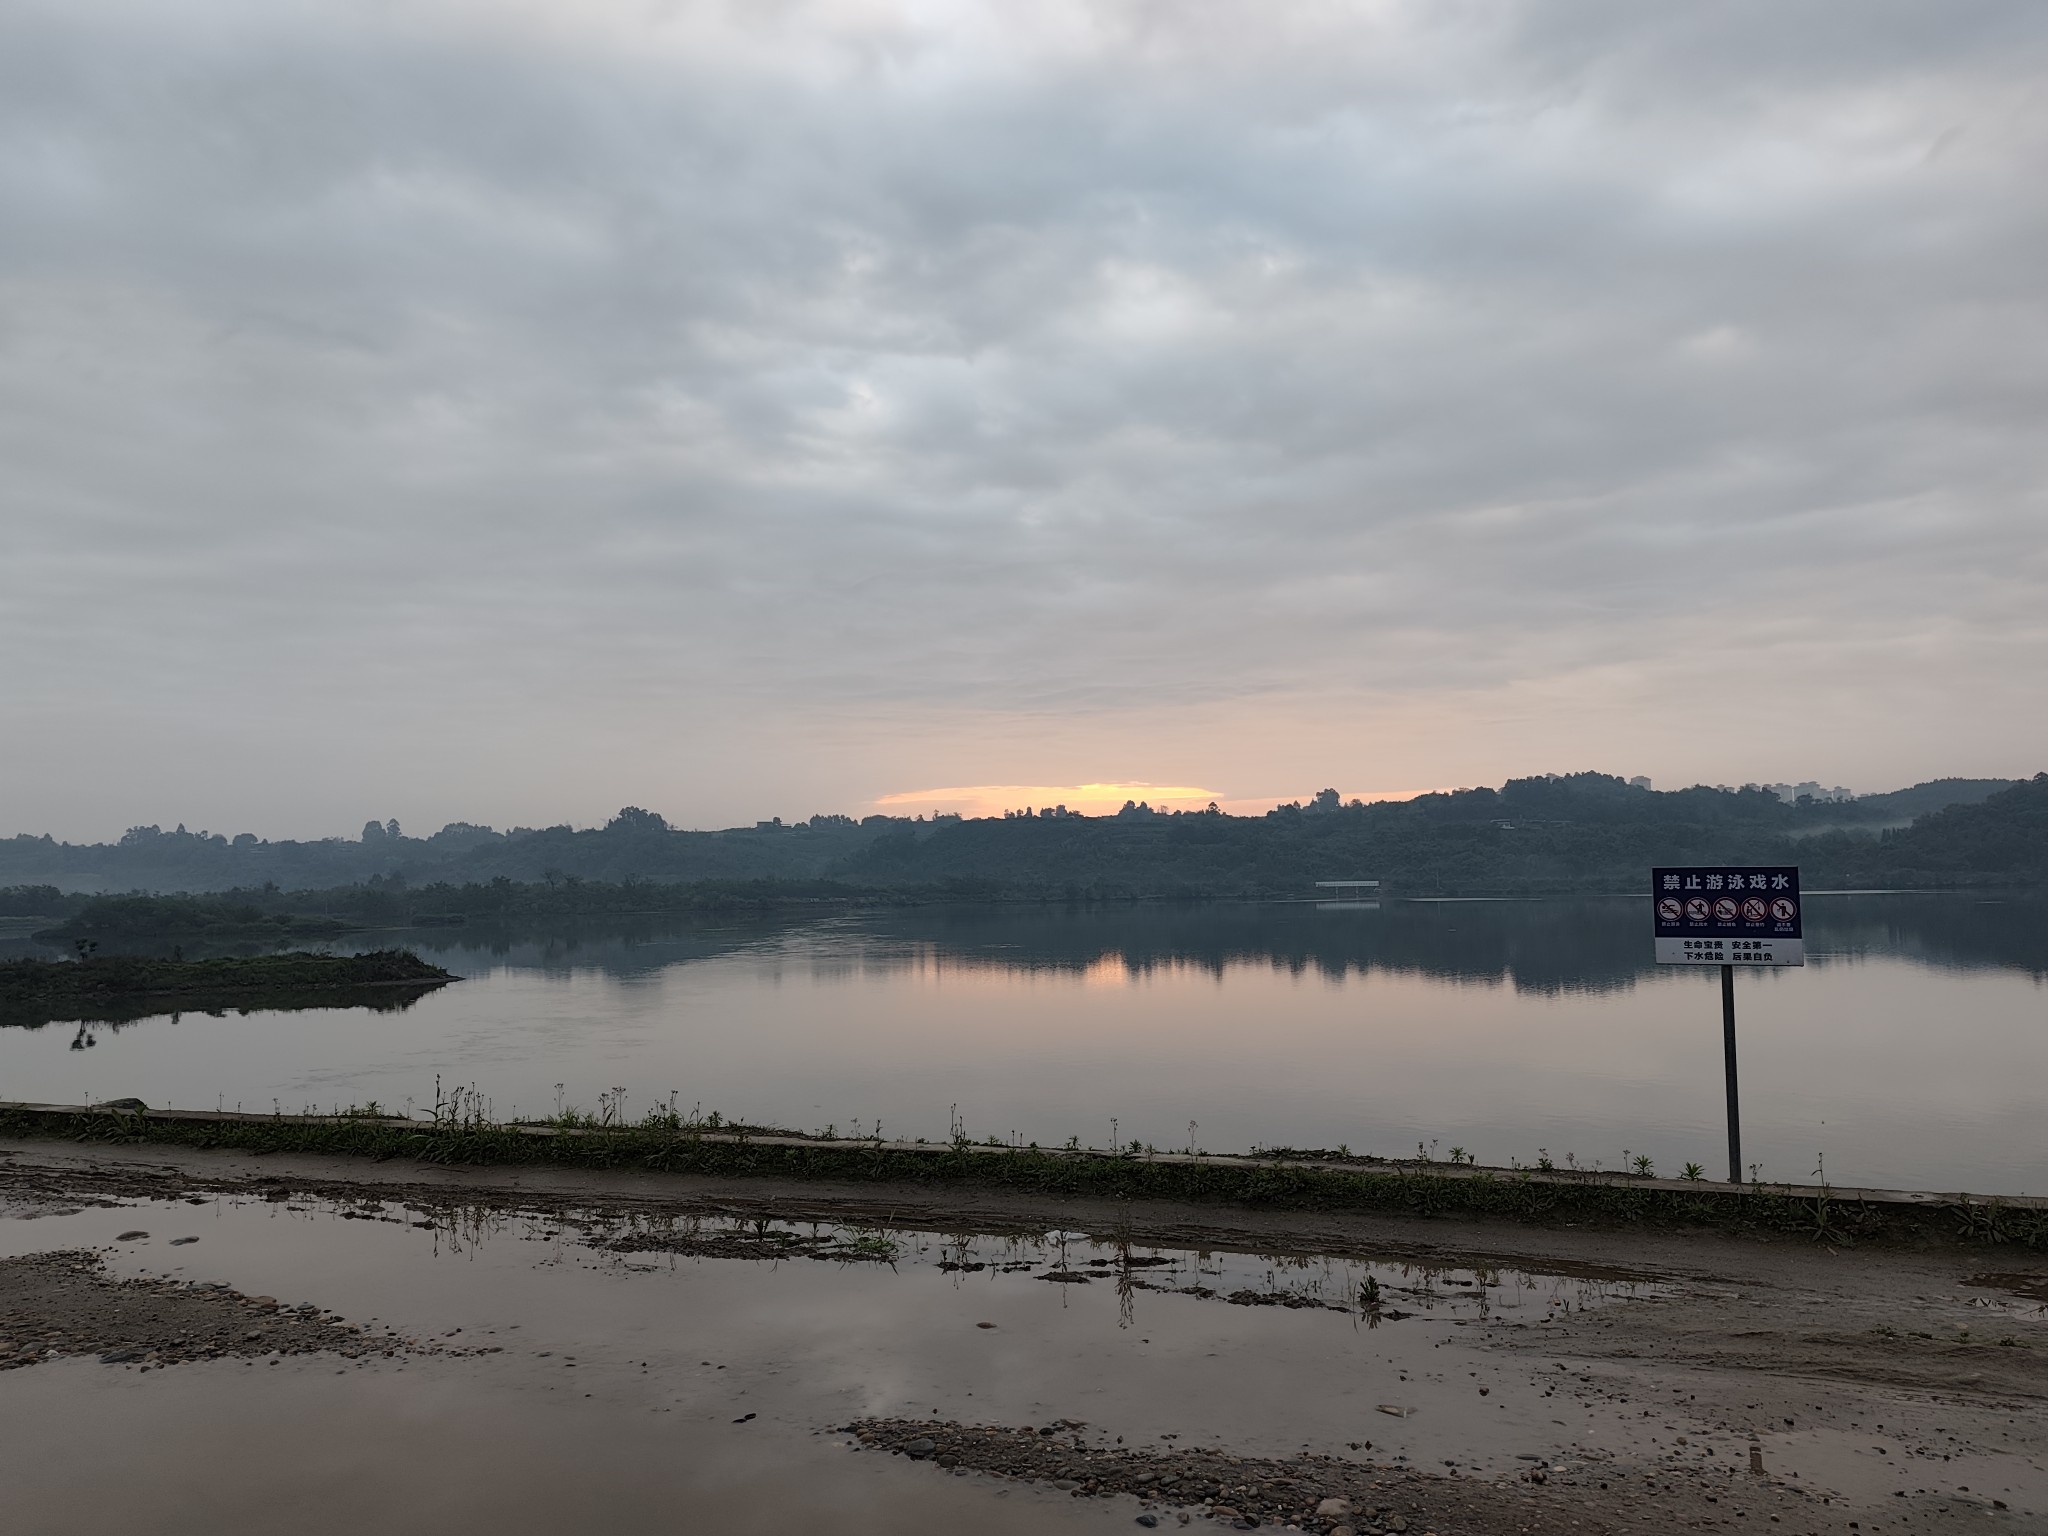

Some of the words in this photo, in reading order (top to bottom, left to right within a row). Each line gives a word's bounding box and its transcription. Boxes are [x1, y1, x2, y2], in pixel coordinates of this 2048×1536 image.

[1663, 874, 1790, 890] 禁止游泳戏水
[1683, 940, 1724, 950] 生命宝贵
[1731, 940, 1773, 950] 安全第一
[1684, 951, 1725, 961] 下水危险
[1732, 952, 1774, 962] 后果自负
